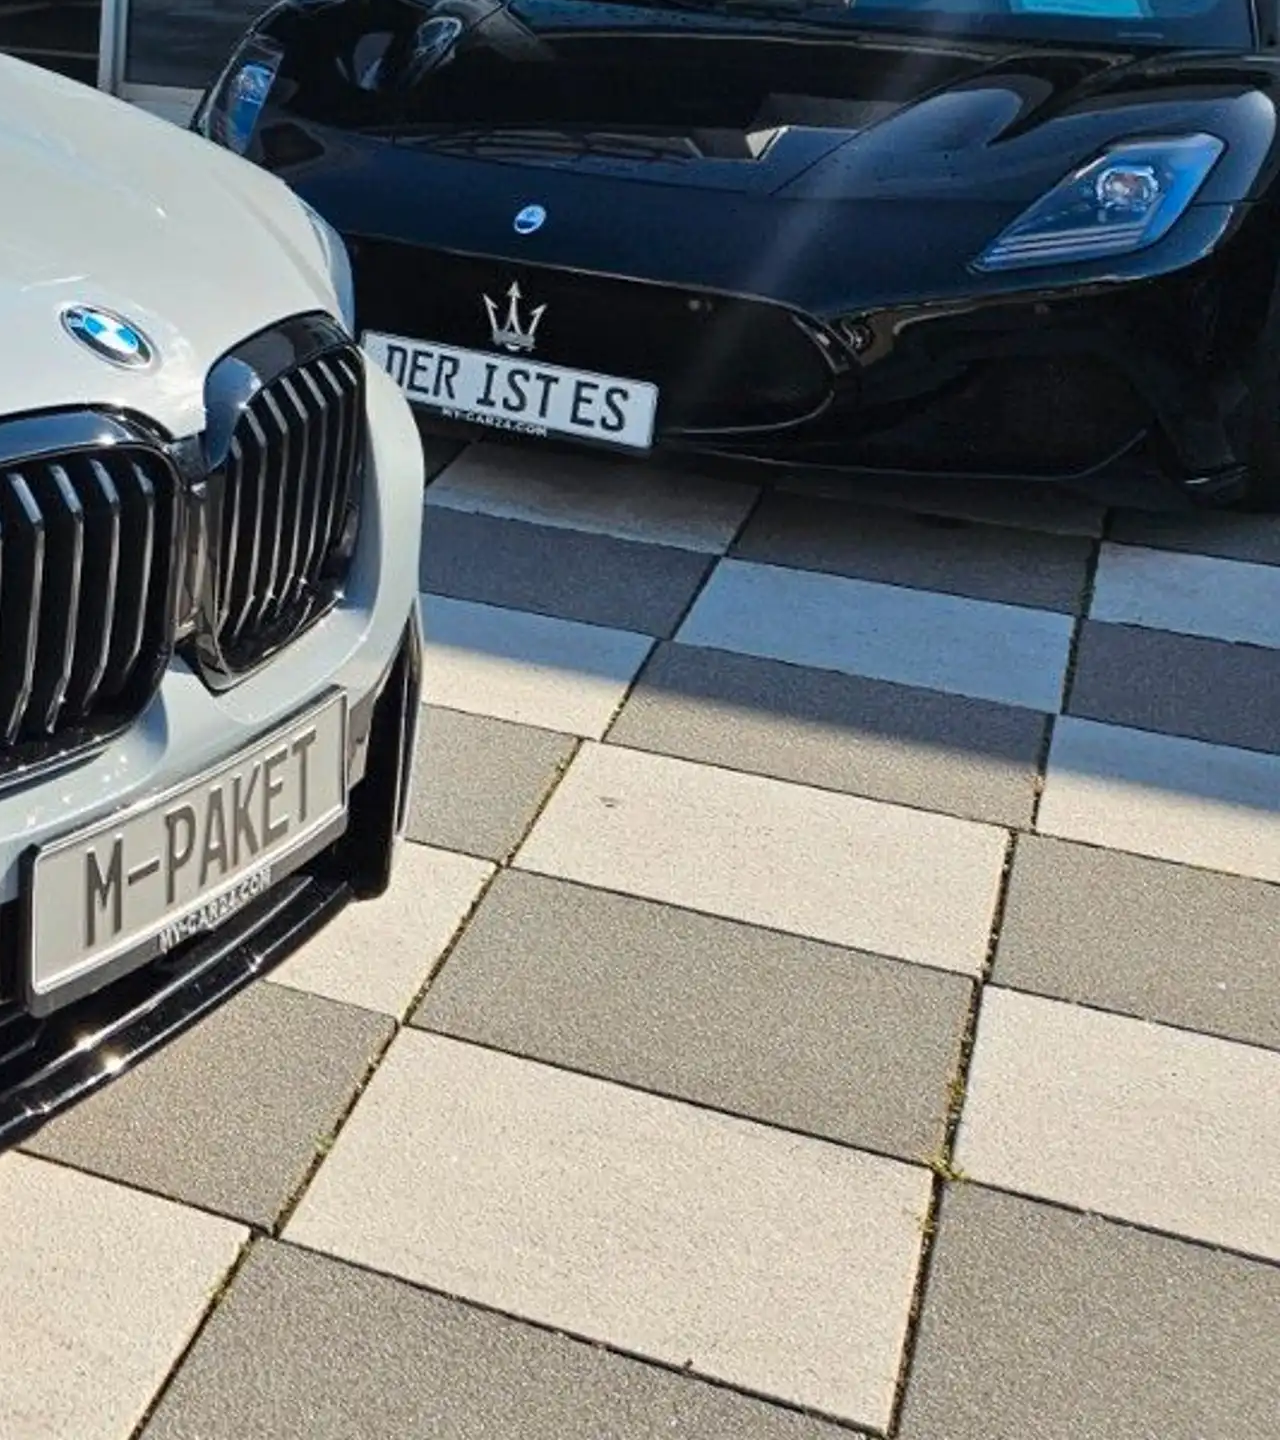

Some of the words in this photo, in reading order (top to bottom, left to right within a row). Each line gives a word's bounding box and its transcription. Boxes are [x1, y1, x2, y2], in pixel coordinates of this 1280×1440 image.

[475, 362, 559, 419] IST
[569, 380, 630, 434] ES
[83, 723, 318, 950] M-PAKET
